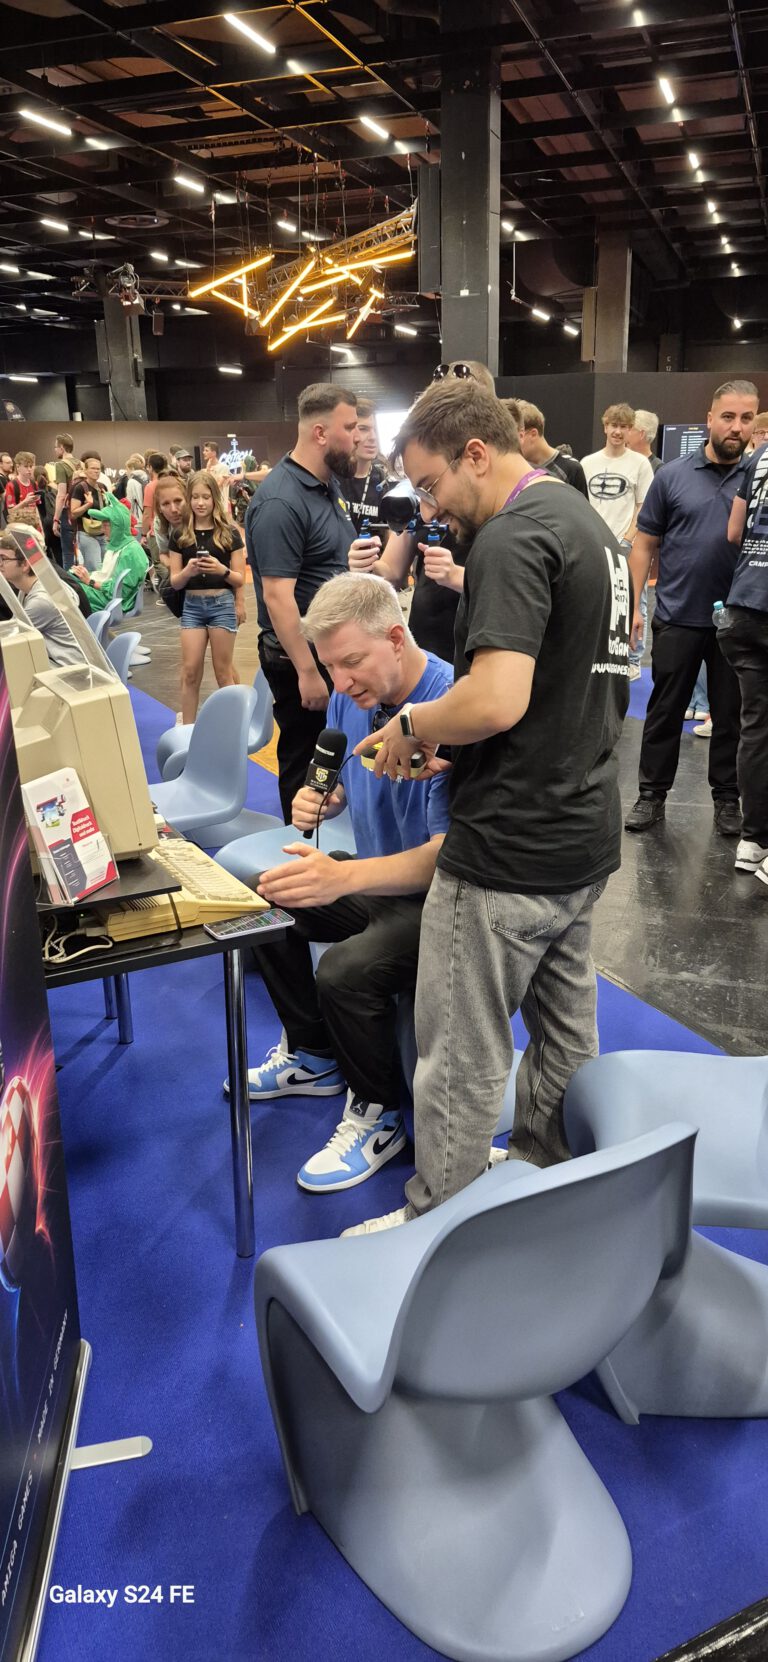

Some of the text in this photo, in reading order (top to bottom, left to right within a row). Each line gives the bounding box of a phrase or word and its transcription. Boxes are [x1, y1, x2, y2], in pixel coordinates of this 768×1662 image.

[2, 1308, 67, 1607] AMIGA GAMES MADE IN GERMANY
